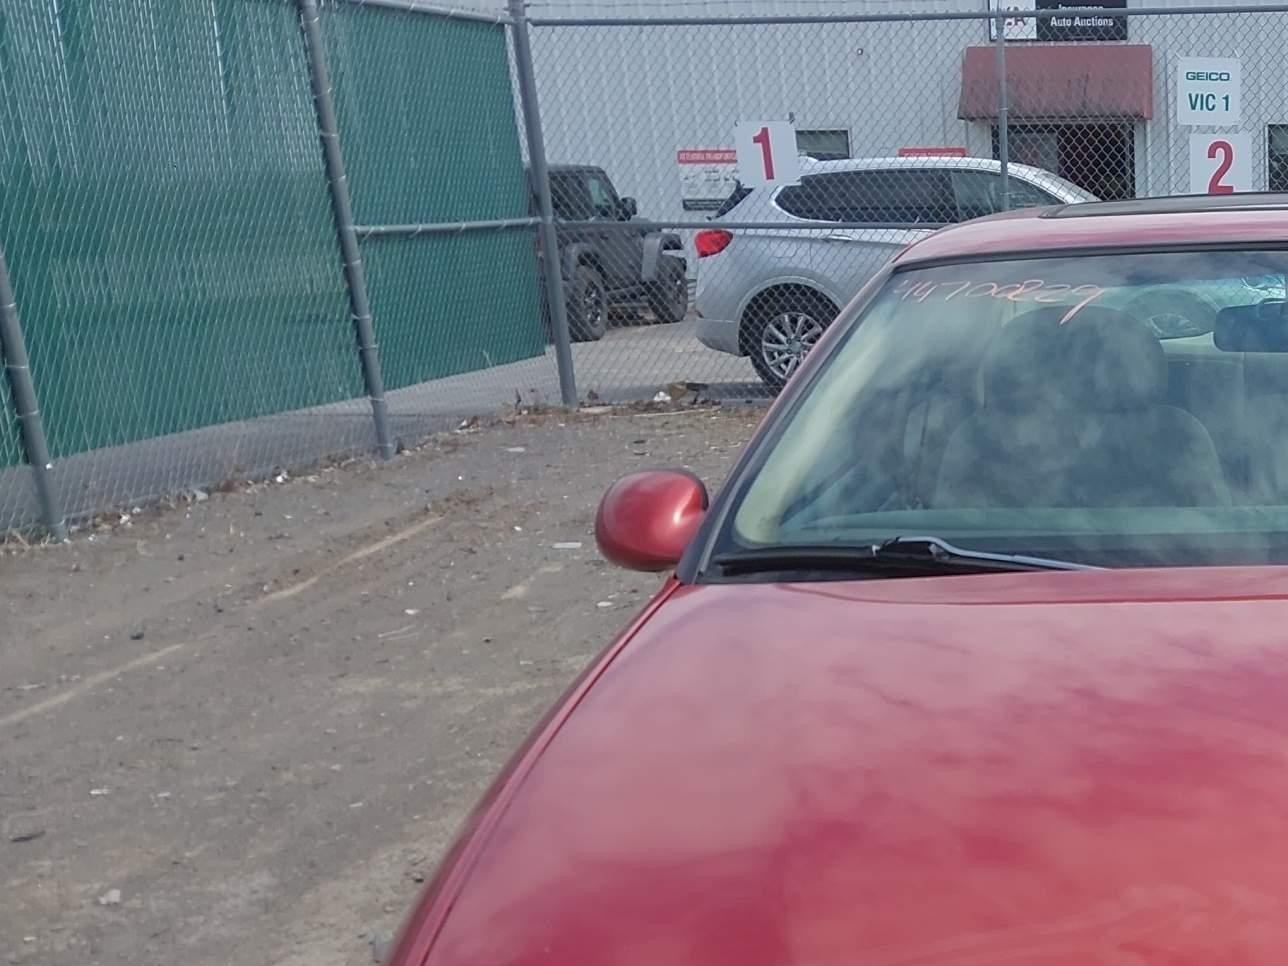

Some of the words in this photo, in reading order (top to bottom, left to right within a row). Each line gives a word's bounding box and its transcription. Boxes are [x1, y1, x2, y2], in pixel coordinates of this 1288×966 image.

[1050, 16, 1071, 27] Auto
[1073, 16, 1114, 27] Auctions
[1185, 71, 1230, 81] GEICO
[1188, 93, 1216, 112] VIC
[1221, 94, 1230, 112] 1
[752, 126, 775, 180] 1
[1207, 140, 1234, 196] 2
